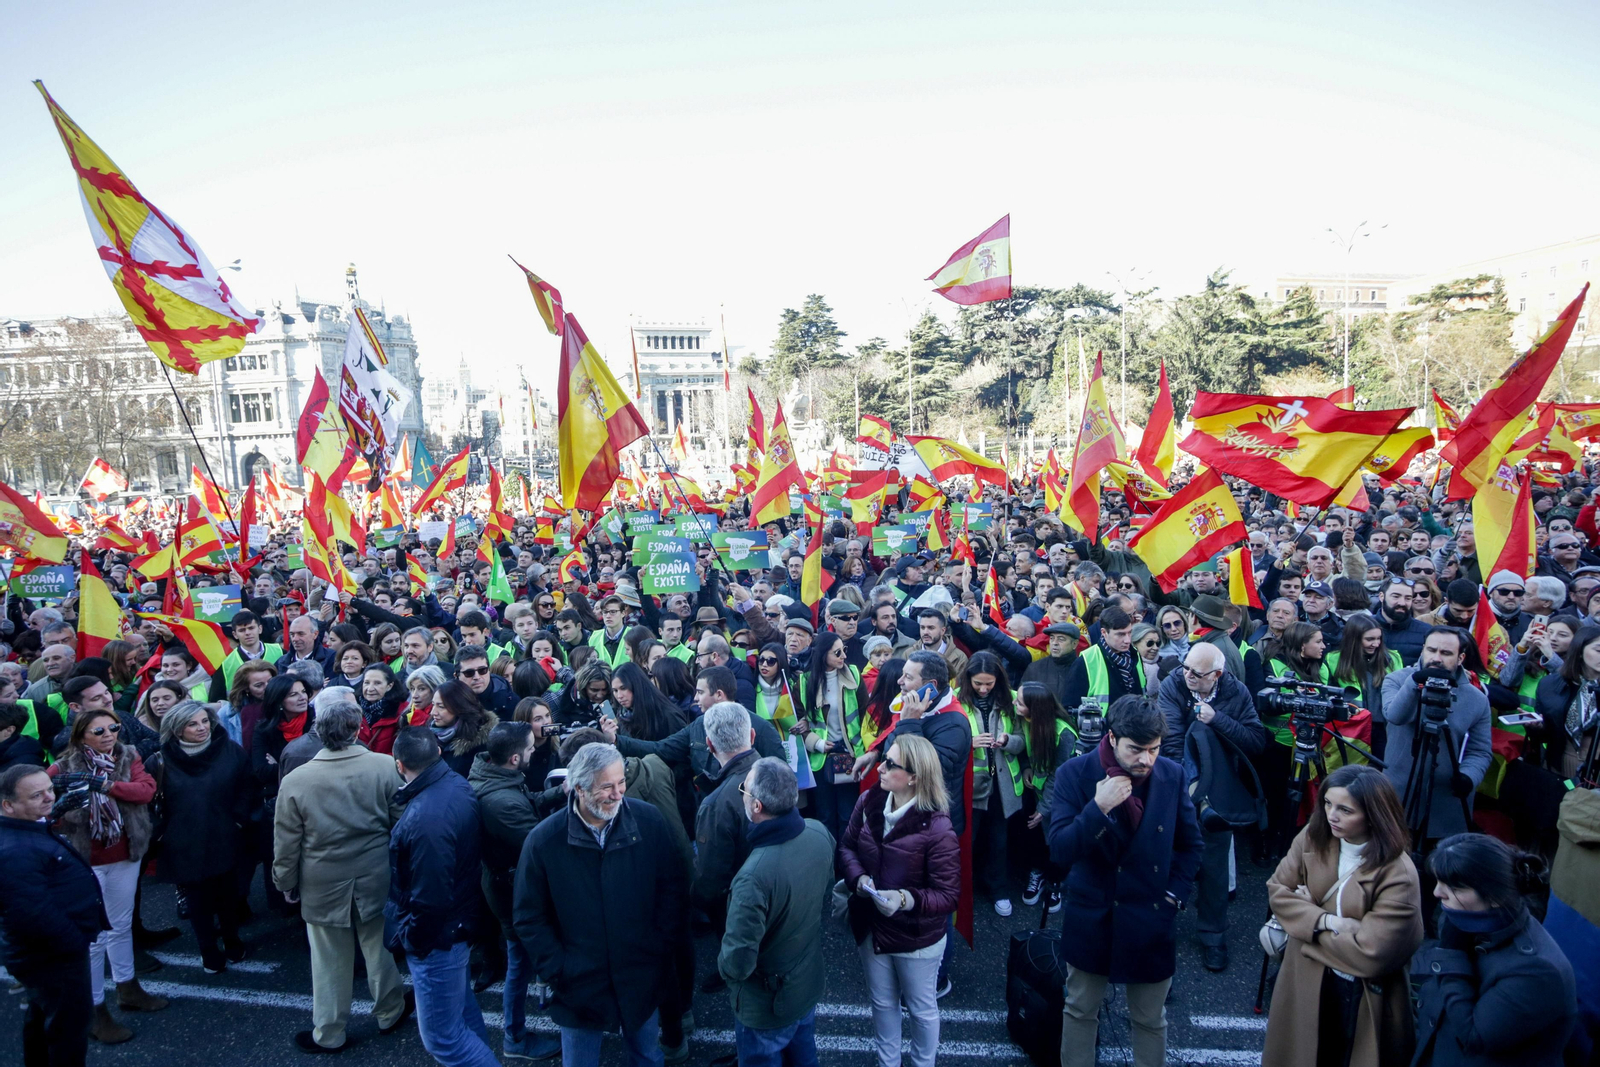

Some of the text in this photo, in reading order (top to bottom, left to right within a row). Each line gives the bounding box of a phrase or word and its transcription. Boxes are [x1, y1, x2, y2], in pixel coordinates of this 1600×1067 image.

[455, 518, 471, 530] PAÑA
[629, 514, 655, 525] ESPAÑA
[681, 520, 711, 531] ESPAÑA
[904, 515, 930, 525] ESPAÑ
[658, 528, 677, 537] ESPA
[648, 541, 682, 553] ESPAÑA
[218, 550, 252, 562] ESPAA
[649, 559, 690, 576] ESPAÑA
[20, 572, 65, 584] ESPAÑA
[654, 576, 686, 588] EXISTE
[25, 584, 60, 594] EXISTE
